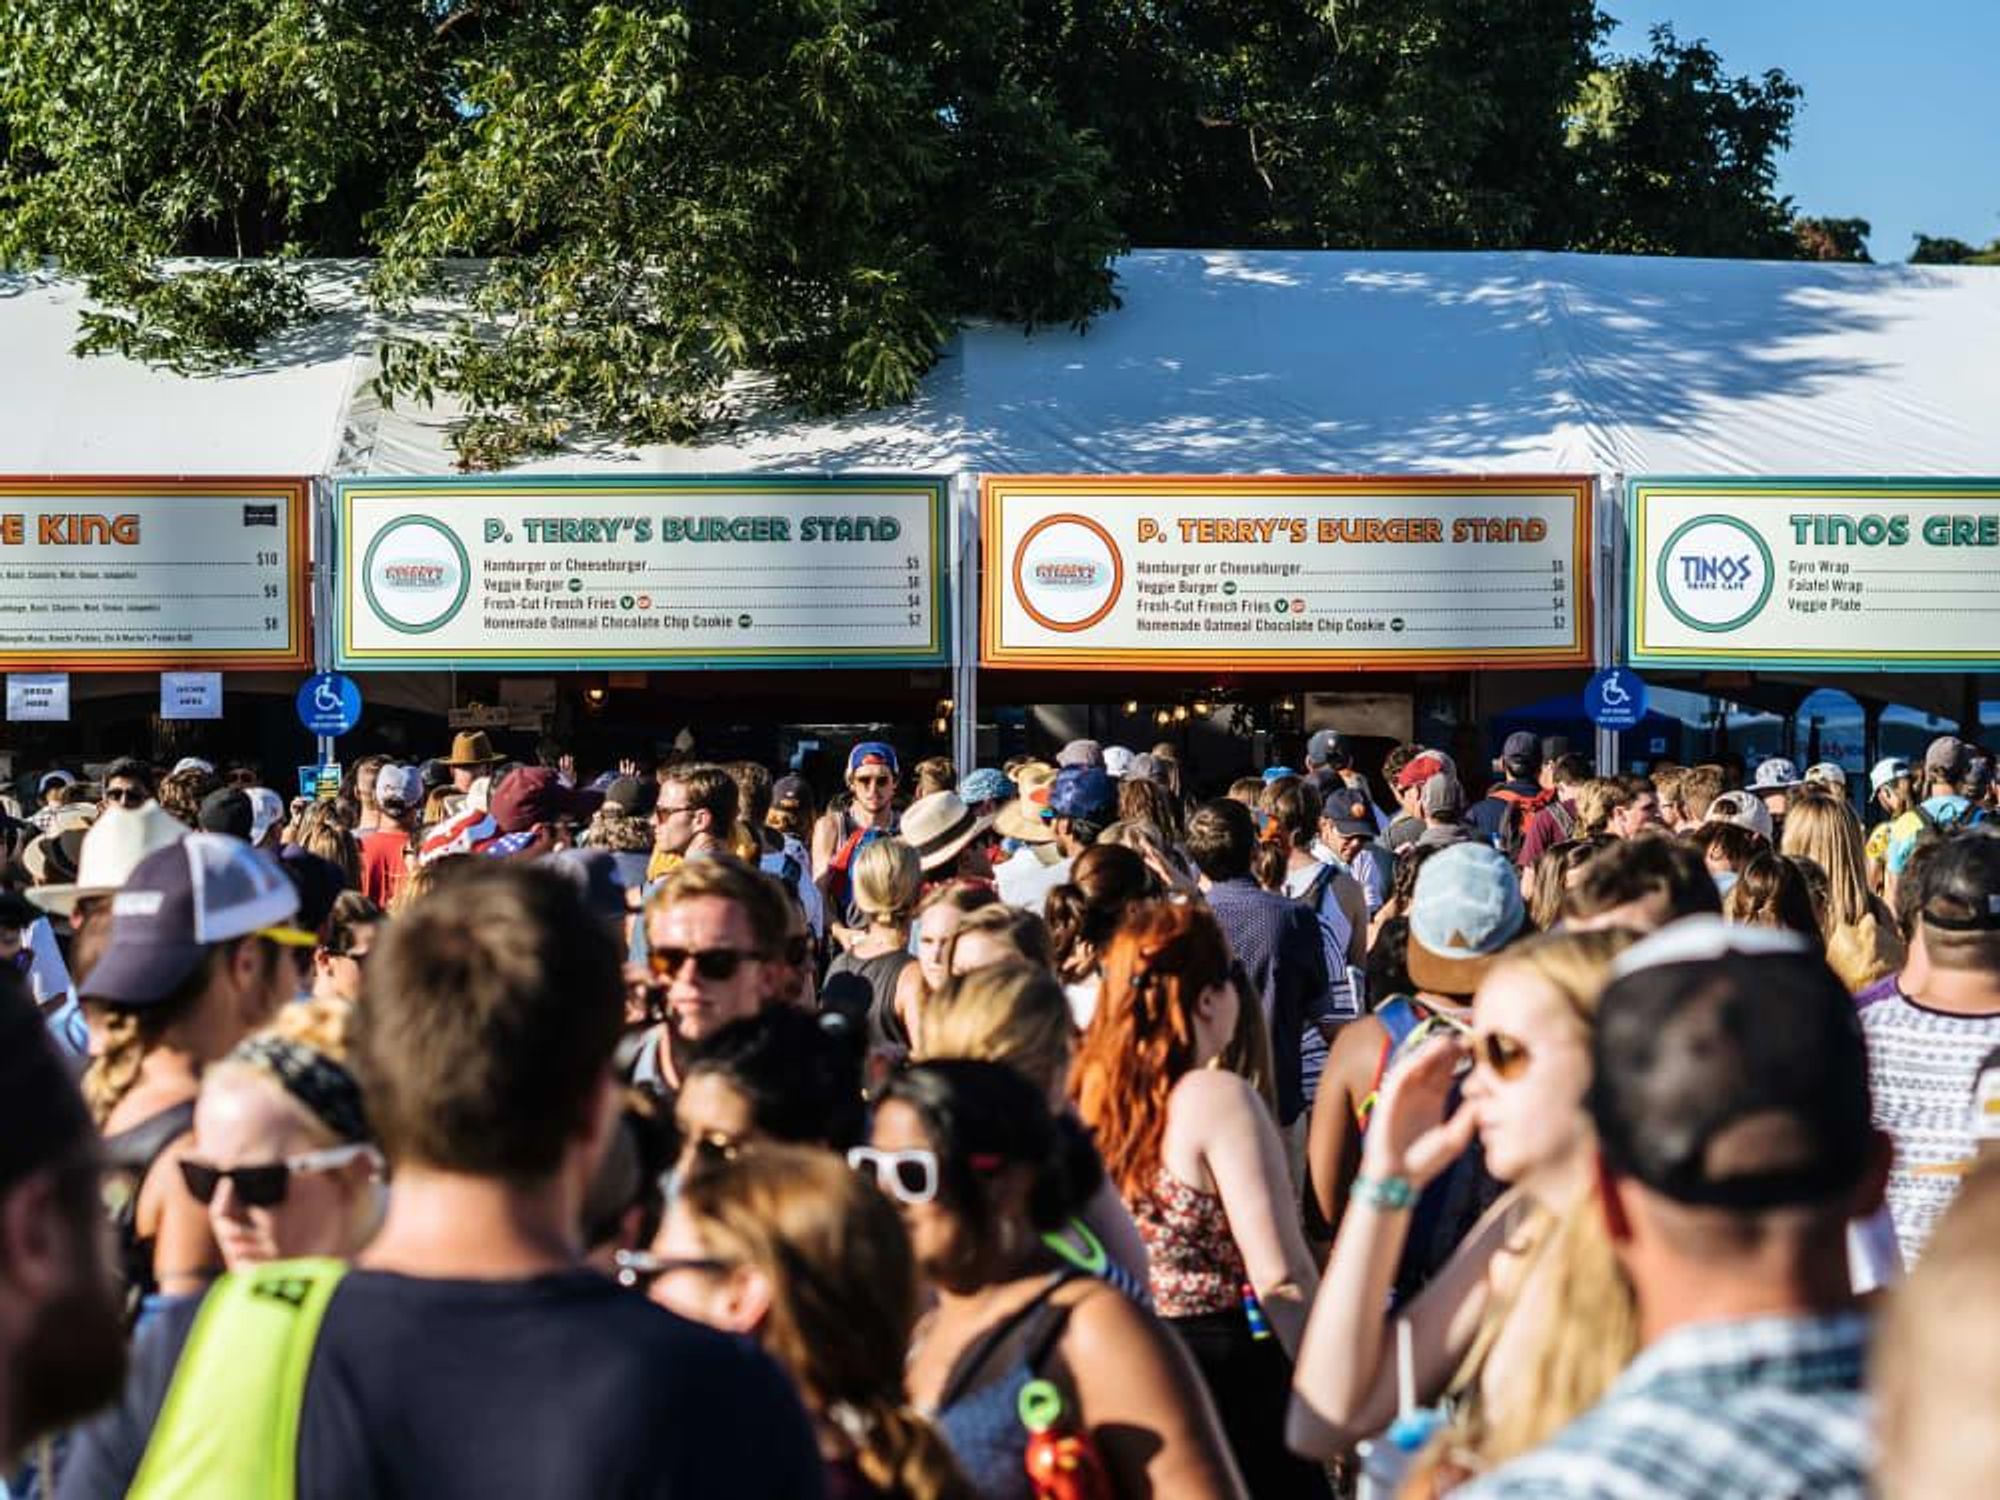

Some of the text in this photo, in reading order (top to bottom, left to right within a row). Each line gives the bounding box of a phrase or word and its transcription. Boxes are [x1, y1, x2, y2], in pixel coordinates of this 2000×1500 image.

[0, 513, 140, 545] E KING
[483, 515, 901, 544] P. TERRY'S BURGER STAND
[1138, 517, 1548, 544] P. TERRY'S BURGER STAND
[1789, 513, 1910, 546] TINOS
[257, 552, 278, 567] $10
[484, 558, 648, 575] Hamburger or Cheeseburger
[1137, 561, 1302, 578] Hamburger or Cheeseburger
[1680, 554, 1752, 582] TINOS
[1788, 560, 1850, 576] Gyro Wrap
[484, 579, 523, 595] Veggie
[525, 579, 565, 595] Burger
[1137, 581, 1176, 597] Veggie
[1178, 581, 1219, 597] Burger
[1788, 579, 1864, 594] Falafel Wrap
[484, 597, 540, 611] Fresh-Cut
[544, 597, 584, 611] French
[587, 597, 617, 611] Fries
[1137, 599, 1195, 613] Fresh-Cut
[1198, 599, 1238, 613] French
[1242, 599, 1271, 613] Fries
[1788, 597, 1862, 613] Veggie Plate
[484, 616, 547, 630] Homemade
[550, 616, 598, 630] Oatmeal
[601, 615, 660, 629] Chocolate
[663, 614, 689, 631] Chip
[692, 614, 733, 628] Cookie
[1137, 618, 1201, 632] Homemade
[1204, 618, 1252, 632] Oatmeal
[1255, 618, 1314, 632] Chocolate
[1317, 618, 1343, 634] Chip
[1346, 618, 1386, 632] Cookie
